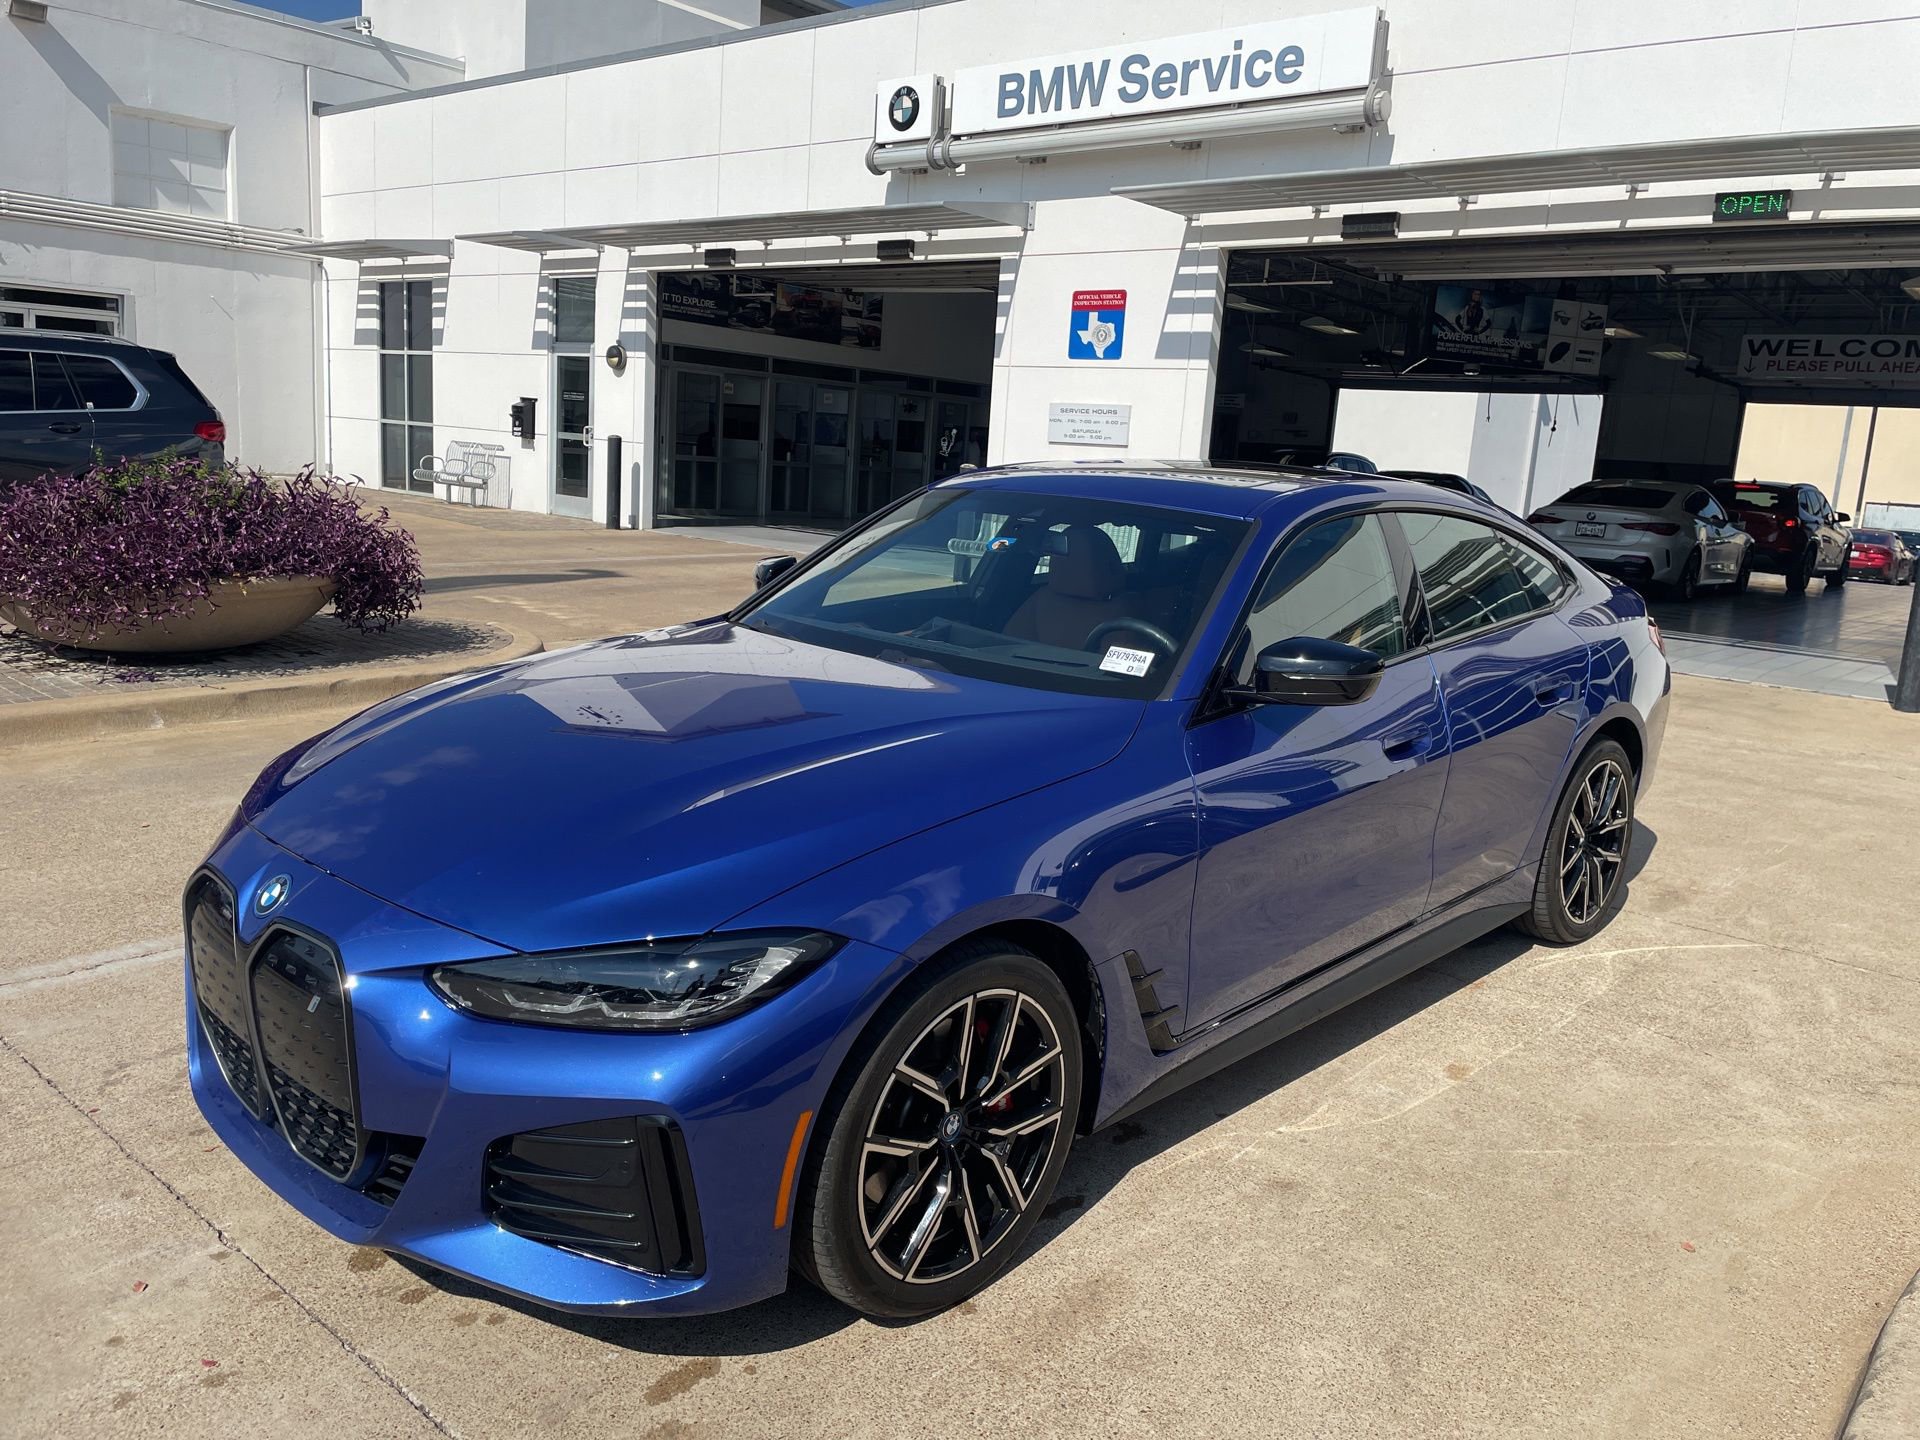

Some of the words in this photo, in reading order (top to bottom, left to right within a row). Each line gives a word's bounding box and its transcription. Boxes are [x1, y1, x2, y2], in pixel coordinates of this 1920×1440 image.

[997, 58, 1112, 119] BMW
[1117, 39, 1306, 103] Service
[1721, 194, 1784, 214] OPEN
[671, 294, 682, 303] TO
[1437, 331, 1481, 344] POWERFUL
[1766, 359, 1828, 372] PLEASE
[1834, 360, 1876, 373] PULL
[1060, 407, 1090, 415] SERVICE
[1106, 650, 1148, 664] SFV79764A
